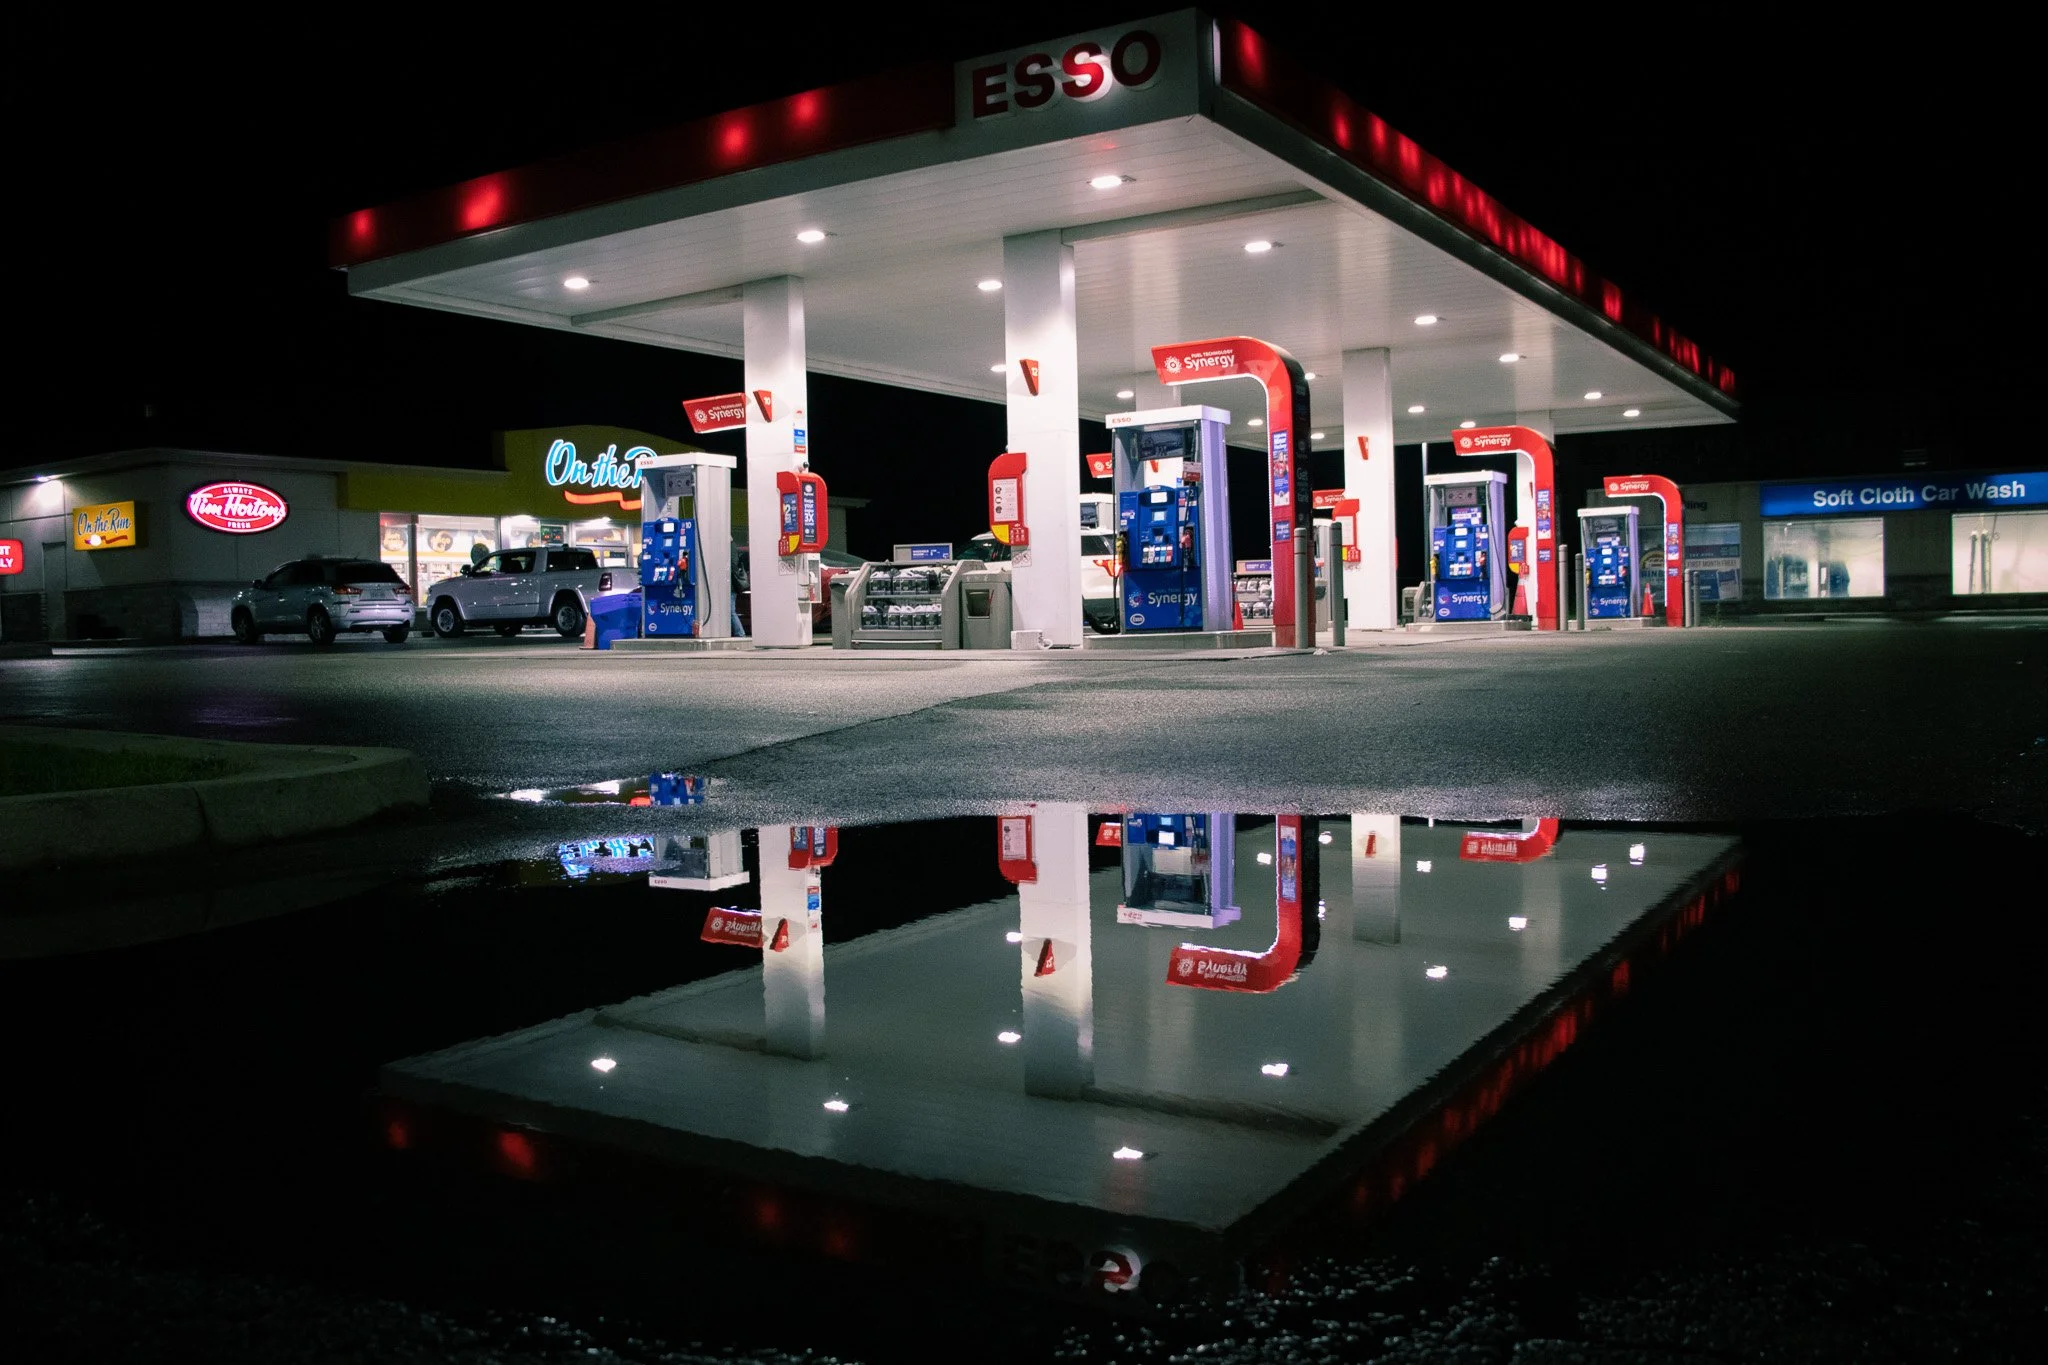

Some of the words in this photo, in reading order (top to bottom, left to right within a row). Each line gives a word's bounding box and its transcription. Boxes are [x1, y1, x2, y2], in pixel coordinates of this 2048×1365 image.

[972, 30, 1161, 118] ESSO
[1184, 355, 1235, 371] Synergy
[763, 397, 771, 406] 10
[708, 407, 745, 421] Synergy
[1474, 437, 1511, 447] Synergy
[546, 440, 592, 487] On
[590, 444, 634, 489] the
[223, 487, 253, 495] ALWAYS
[1620, 482, 1649, 491] Synergy
[1813, 489, 1854, 507] Soft
[1859, 486, 1914, 505] Cloth
[1921, 485, 1959, 502] Car
[1965, 480, 2026, 500] Wash
[190, 493, 222, 517] Tim
[222, 494, 287, 522] Hortons
[77, 511, 93, 536] On
[93, 510, 108, 533] the
[108, 507, 130, 531] Run
[228, 521, 251, 529] FRESH
